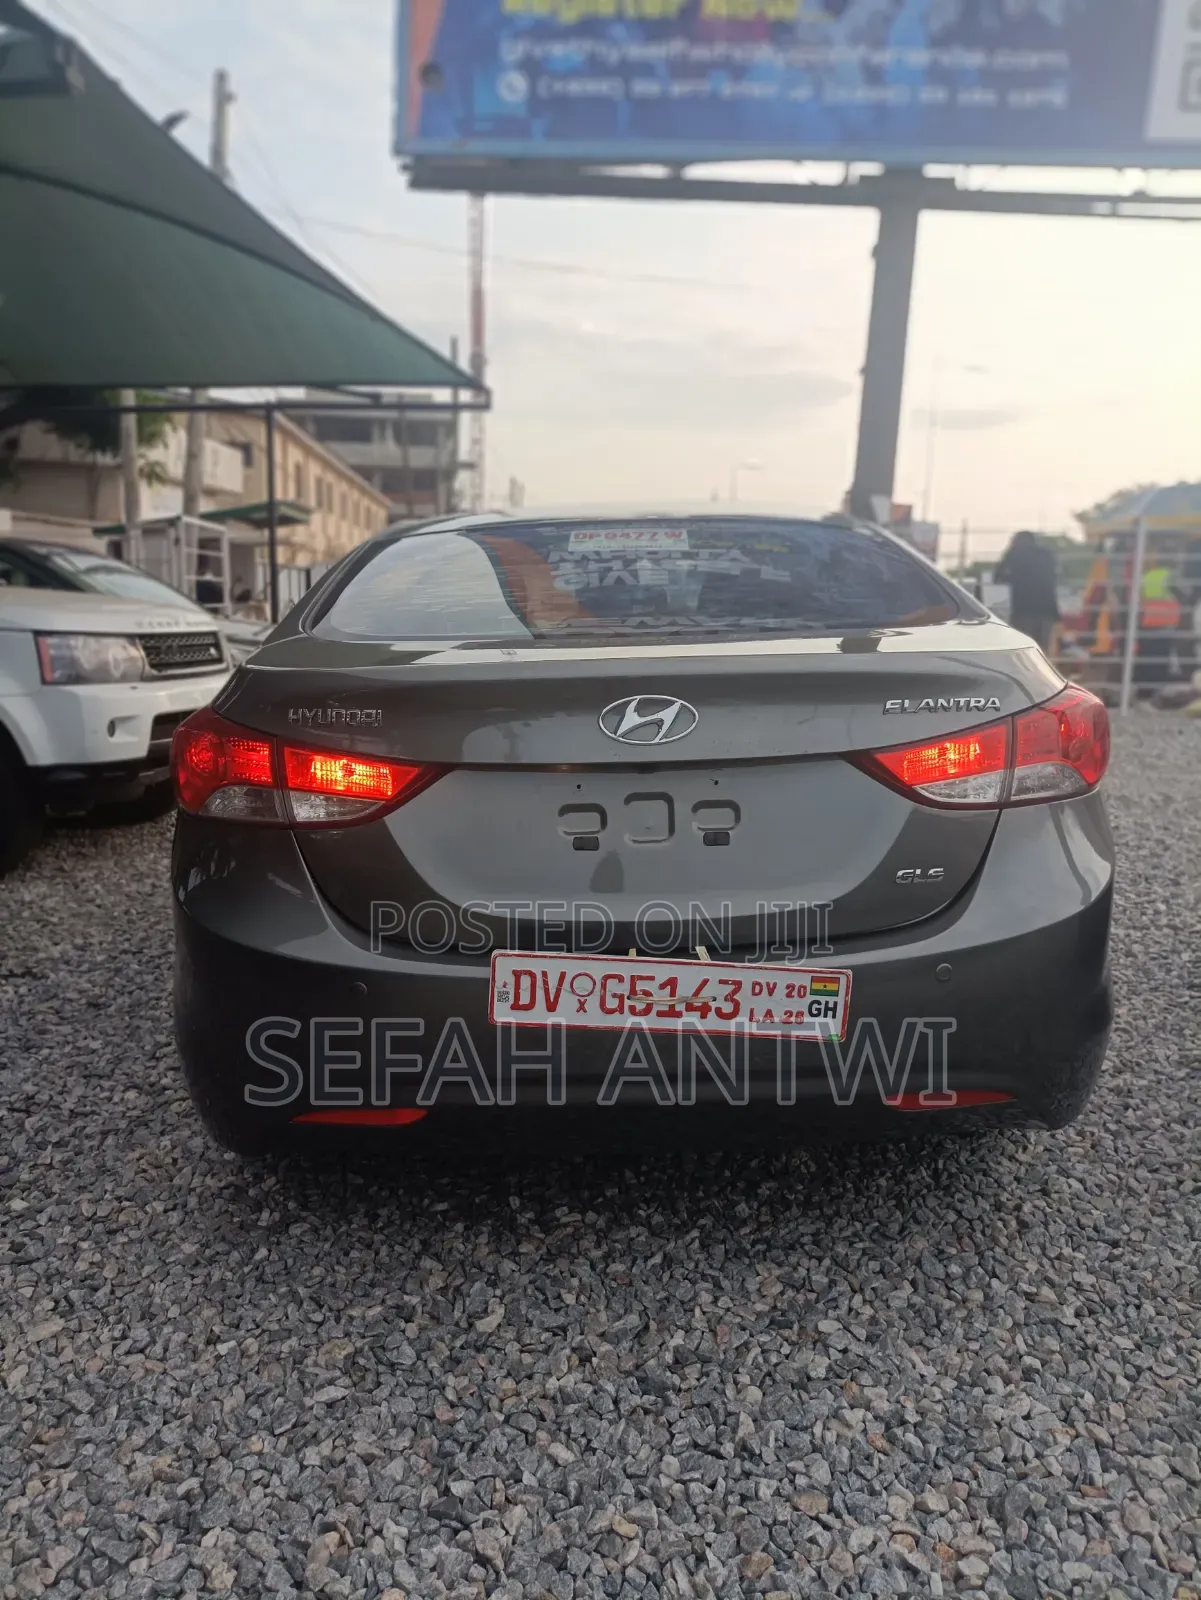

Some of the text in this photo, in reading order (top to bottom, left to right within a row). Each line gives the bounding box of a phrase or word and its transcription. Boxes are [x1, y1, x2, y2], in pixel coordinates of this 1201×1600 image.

[882, 697, 1001, 715] ELANTRA
[288, 707, 383, 727] HYUNDAI
[895, 867, 945, 884] GLS
[509, 968, 743, 1021] DV G5143
[751, 980, 808, 999] DV 20
[749, 1007, 775, 1024] LA
[807, 999, 839, 1019] GH
